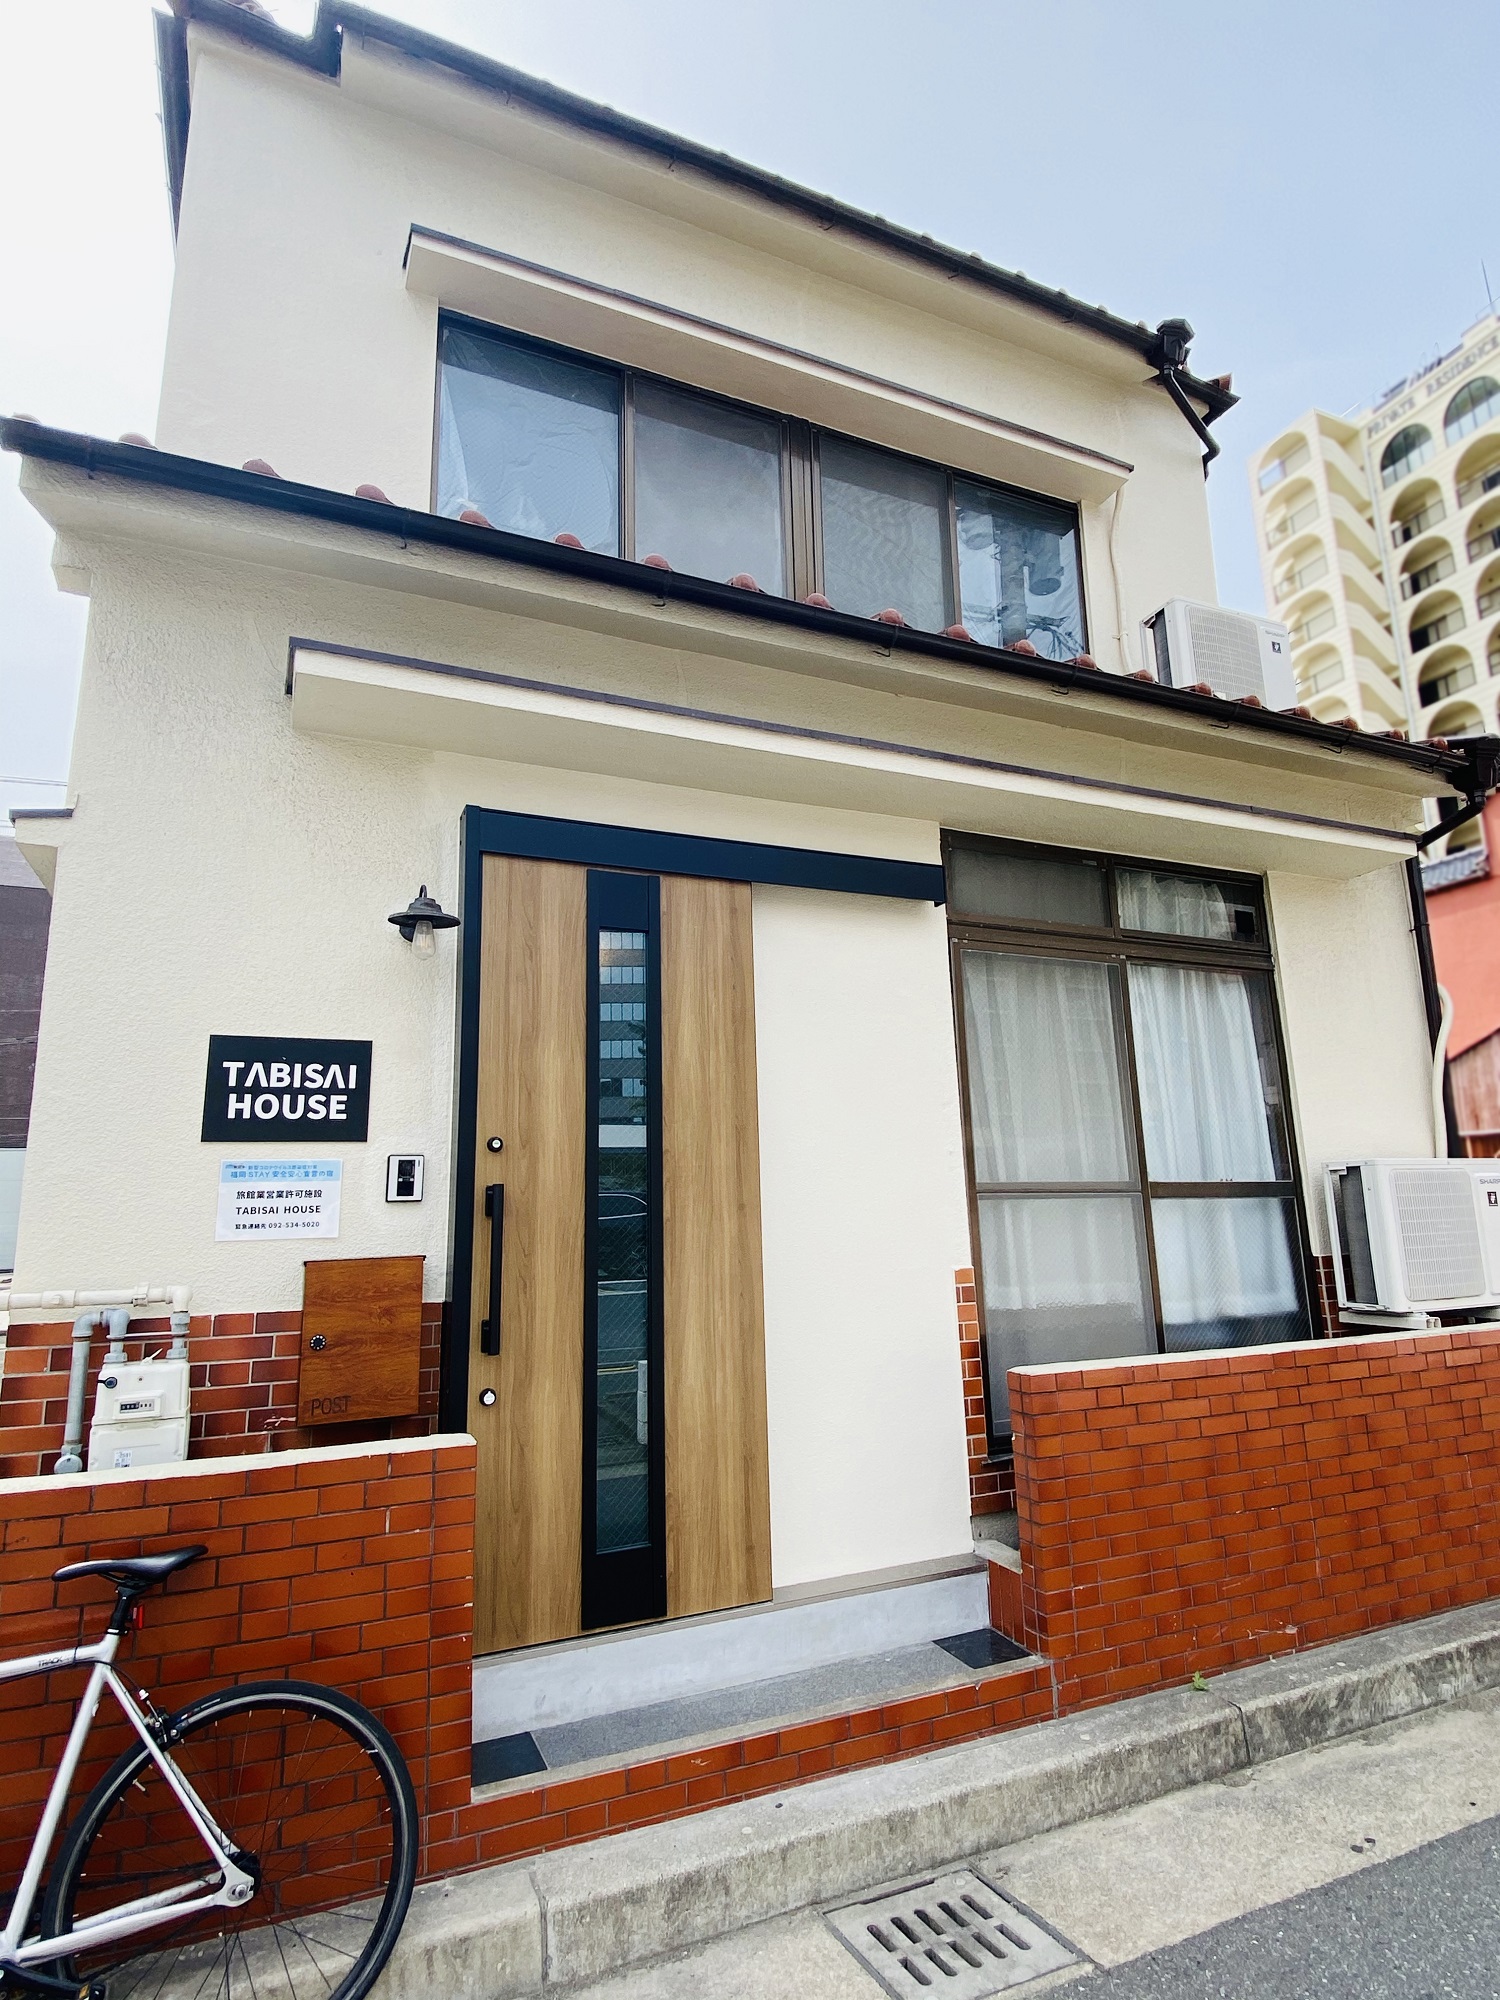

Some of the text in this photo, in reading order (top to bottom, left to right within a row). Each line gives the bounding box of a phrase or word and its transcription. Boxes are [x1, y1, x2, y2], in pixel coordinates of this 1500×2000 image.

[222, 1061, 358, 1089] TABISAI
[227, 1093, 348, 1120] HOUSE
[236, 1189, 323, 1200] 旅館業営業許可施設
[236, 1205, 322, 1215] TABISAI HOUSE
[268, 1221, 320, 1229] 092-534-5020
[311, 1395, 351, 1417] POST
